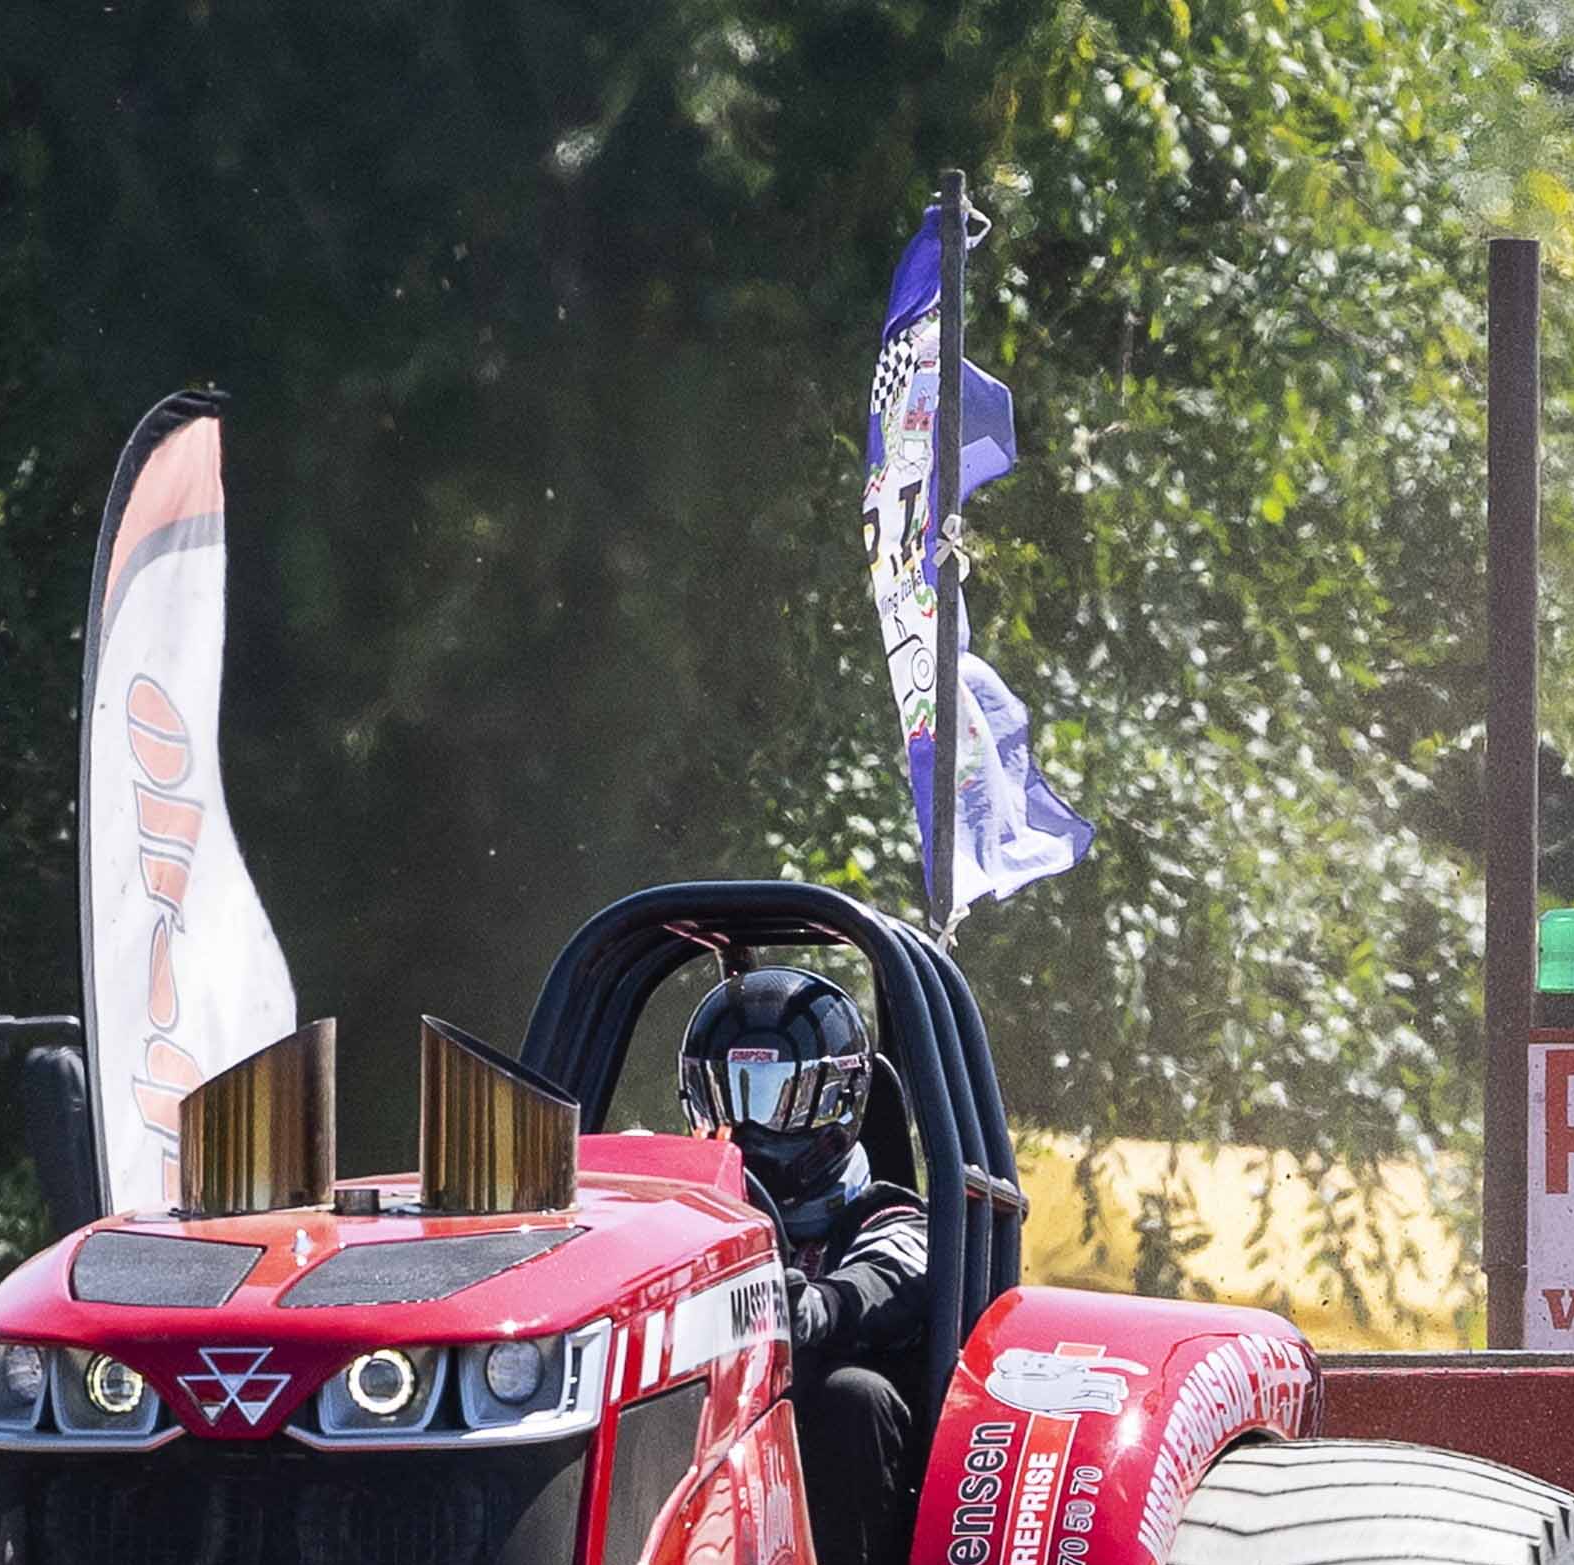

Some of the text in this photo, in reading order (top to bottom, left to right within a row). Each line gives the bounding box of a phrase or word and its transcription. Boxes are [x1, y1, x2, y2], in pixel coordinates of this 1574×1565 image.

[1164, 1341, 1258, 1484] FERGUSON
[1071, 1466, 1103, 1495] 70
[1065, 1500, 1096, 1533] 50
